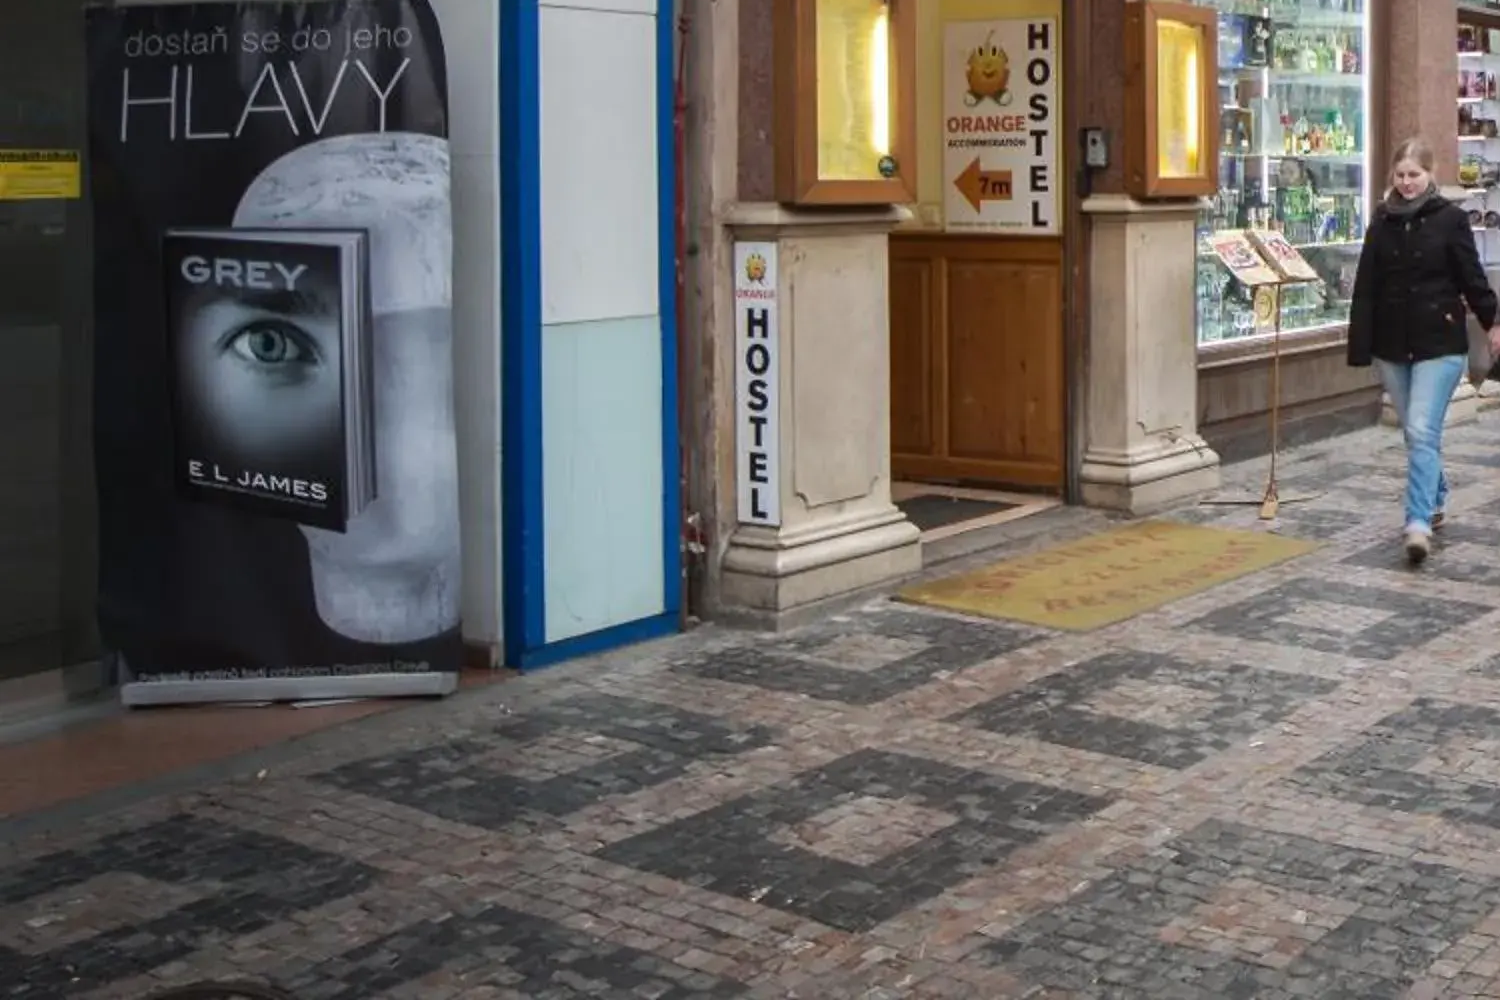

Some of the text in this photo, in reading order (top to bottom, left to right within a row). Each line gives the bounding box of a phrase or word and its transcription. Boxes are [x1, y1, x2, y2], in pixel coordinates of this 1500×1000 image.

[125, 22, 413, 58] dostaň se do jeho
[120, 56, 412, 143] HLAVY
[947, 115, 1026, 133] ORANGE
[1026, 22, 1050, 229] HOSTEL
[181, 256, 309, 292] GREY
[745, 307, 771, 520] HOSTEL
[189, 460, 328, 501] E L JAMES
